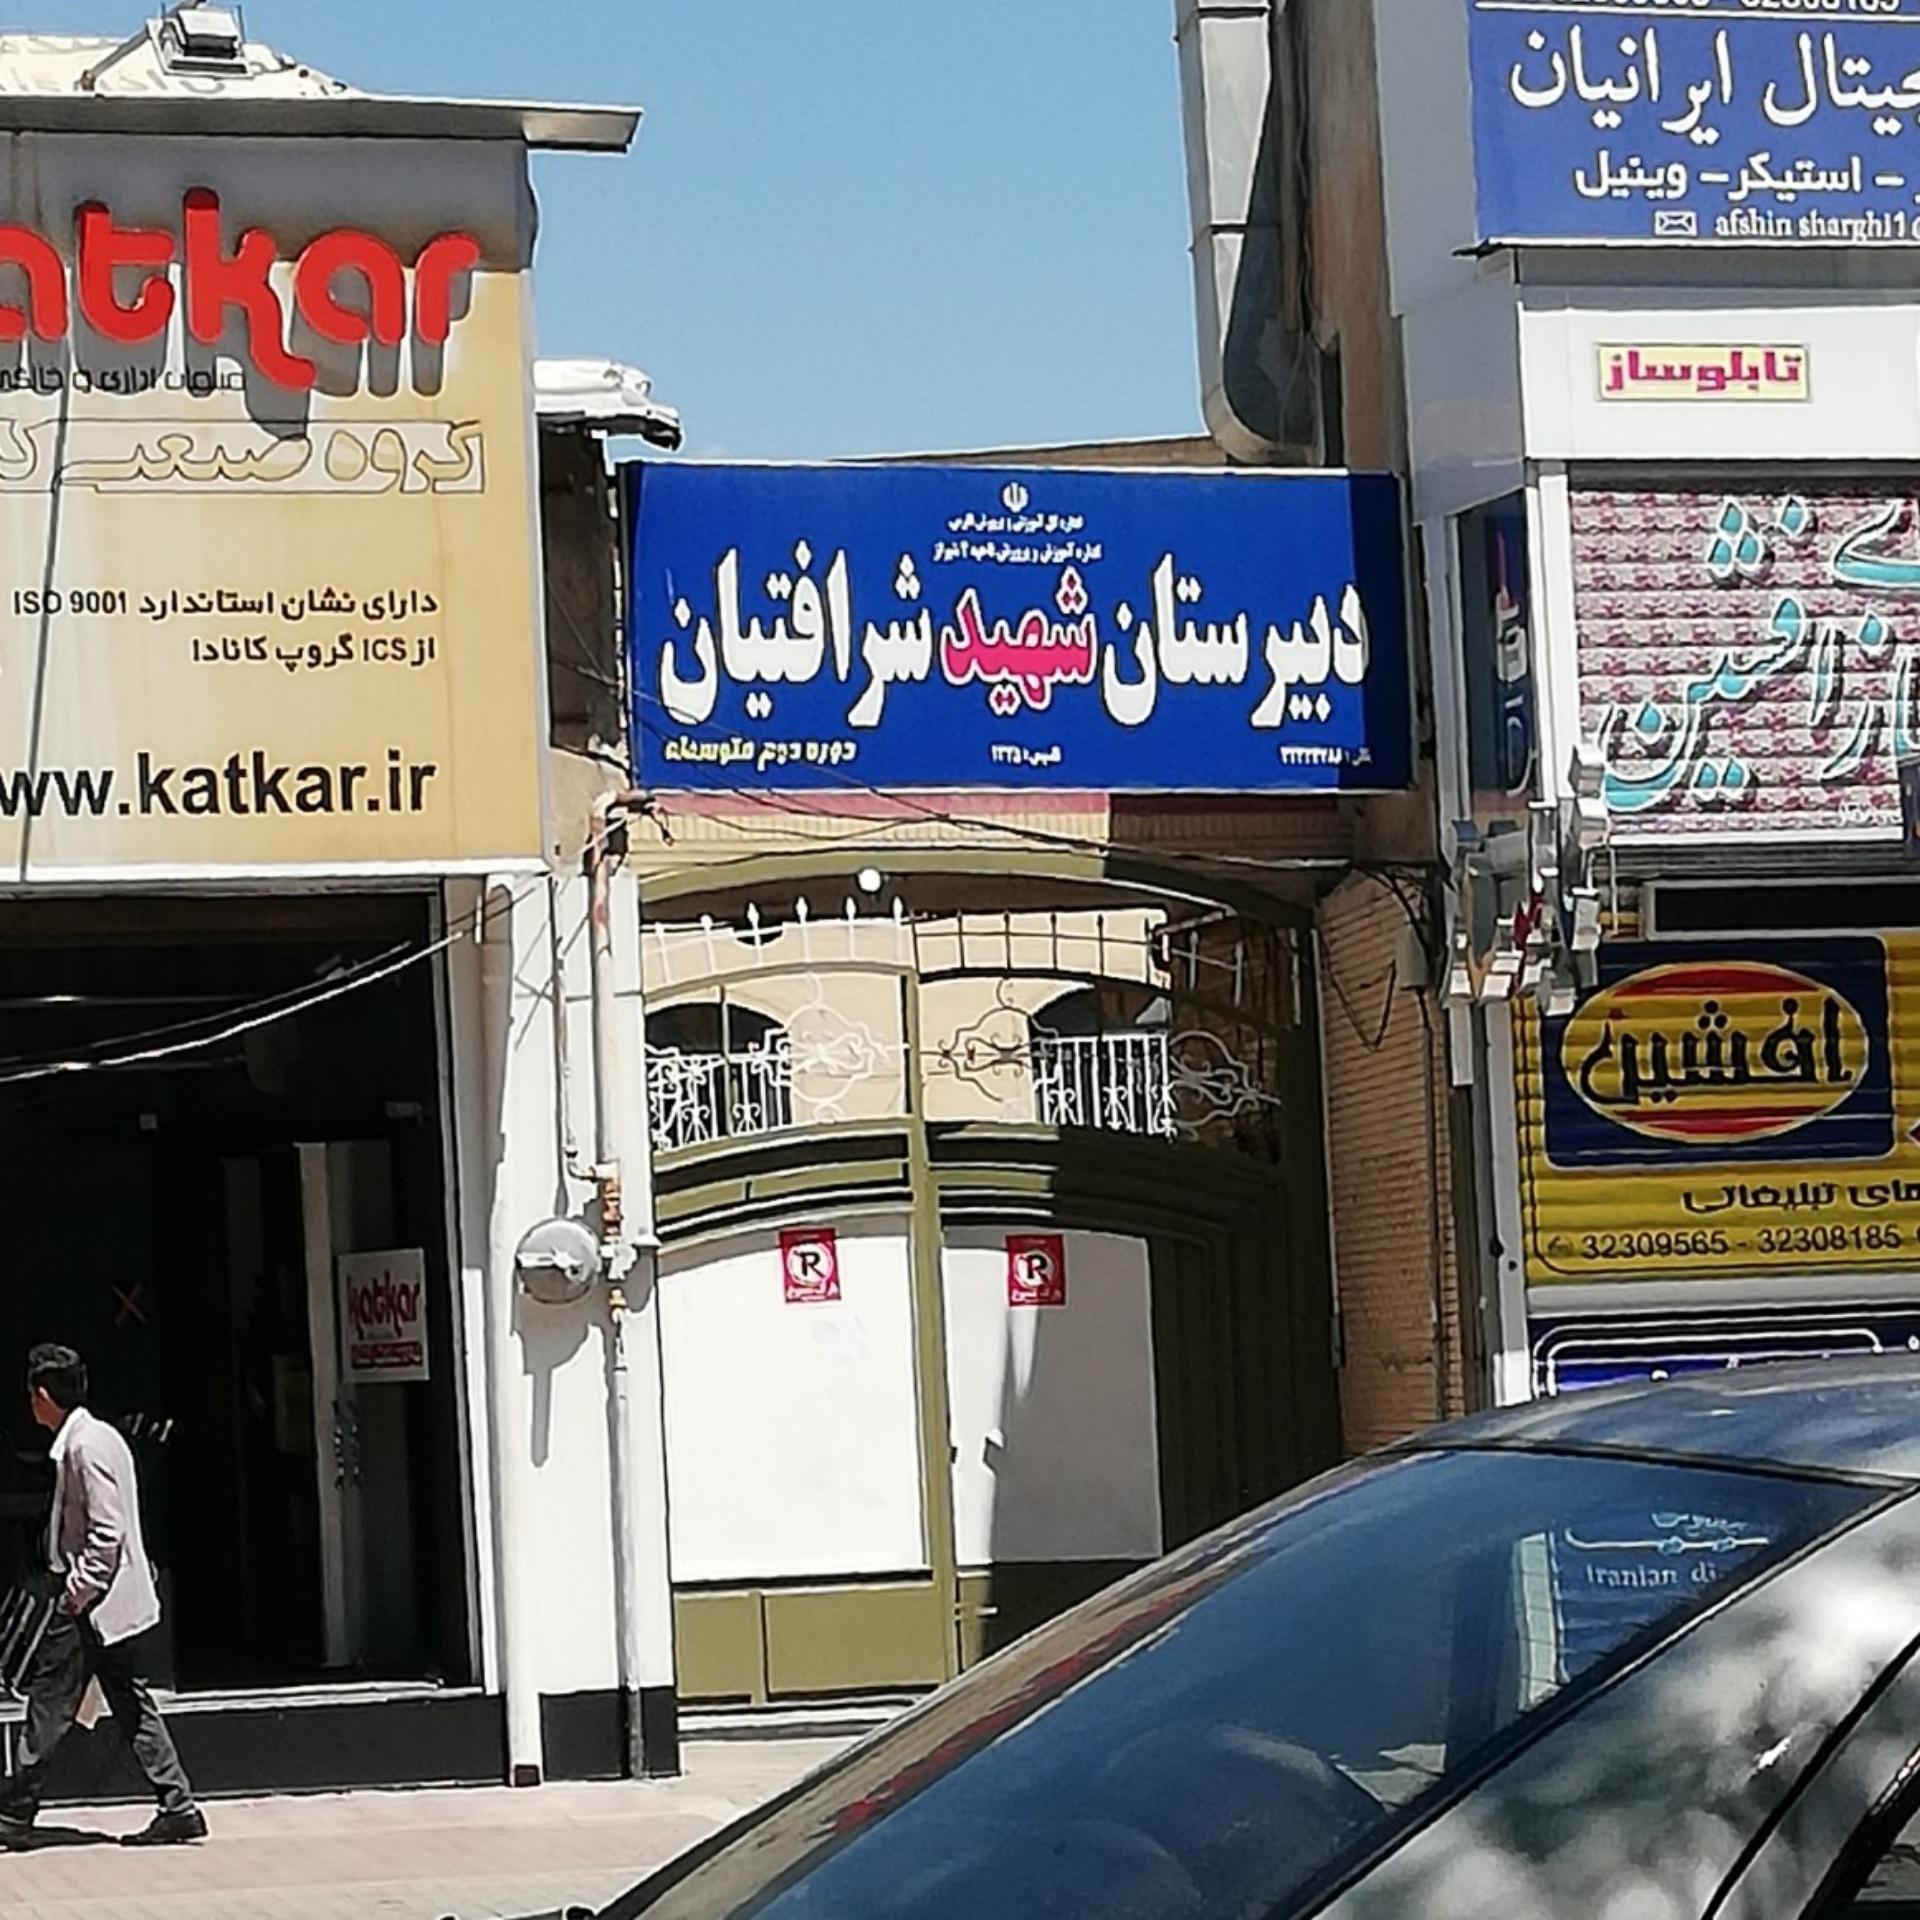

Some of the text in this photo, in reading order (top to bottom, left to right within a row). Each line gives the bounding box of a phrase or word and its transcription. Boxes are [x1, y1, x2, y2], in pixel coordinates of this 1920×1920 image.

[1510, 24, 1733, 145] ایرانیان
[1575, 150, 1688, 199] وینیل
[1715, 208, 1793, 237] afshin
[1606, 350, 1803, 392] تابلوساز
[14, 586, 438, 622] دارای نشان استاندارد ISO 9001
[193, 632, 436, 672] از ICS گروپ کانادا
[659, 540, 932, 727] شرافتیان
[939, 566, 1098, 711] شهید
[1102, 552, 1368, 727] دبیرستان
[1579, 998, 1852, 1105] افشین
[1581, 1231, 1728, 1260] 32309565
[1757, 1223, 1901, 1254] 32308185
